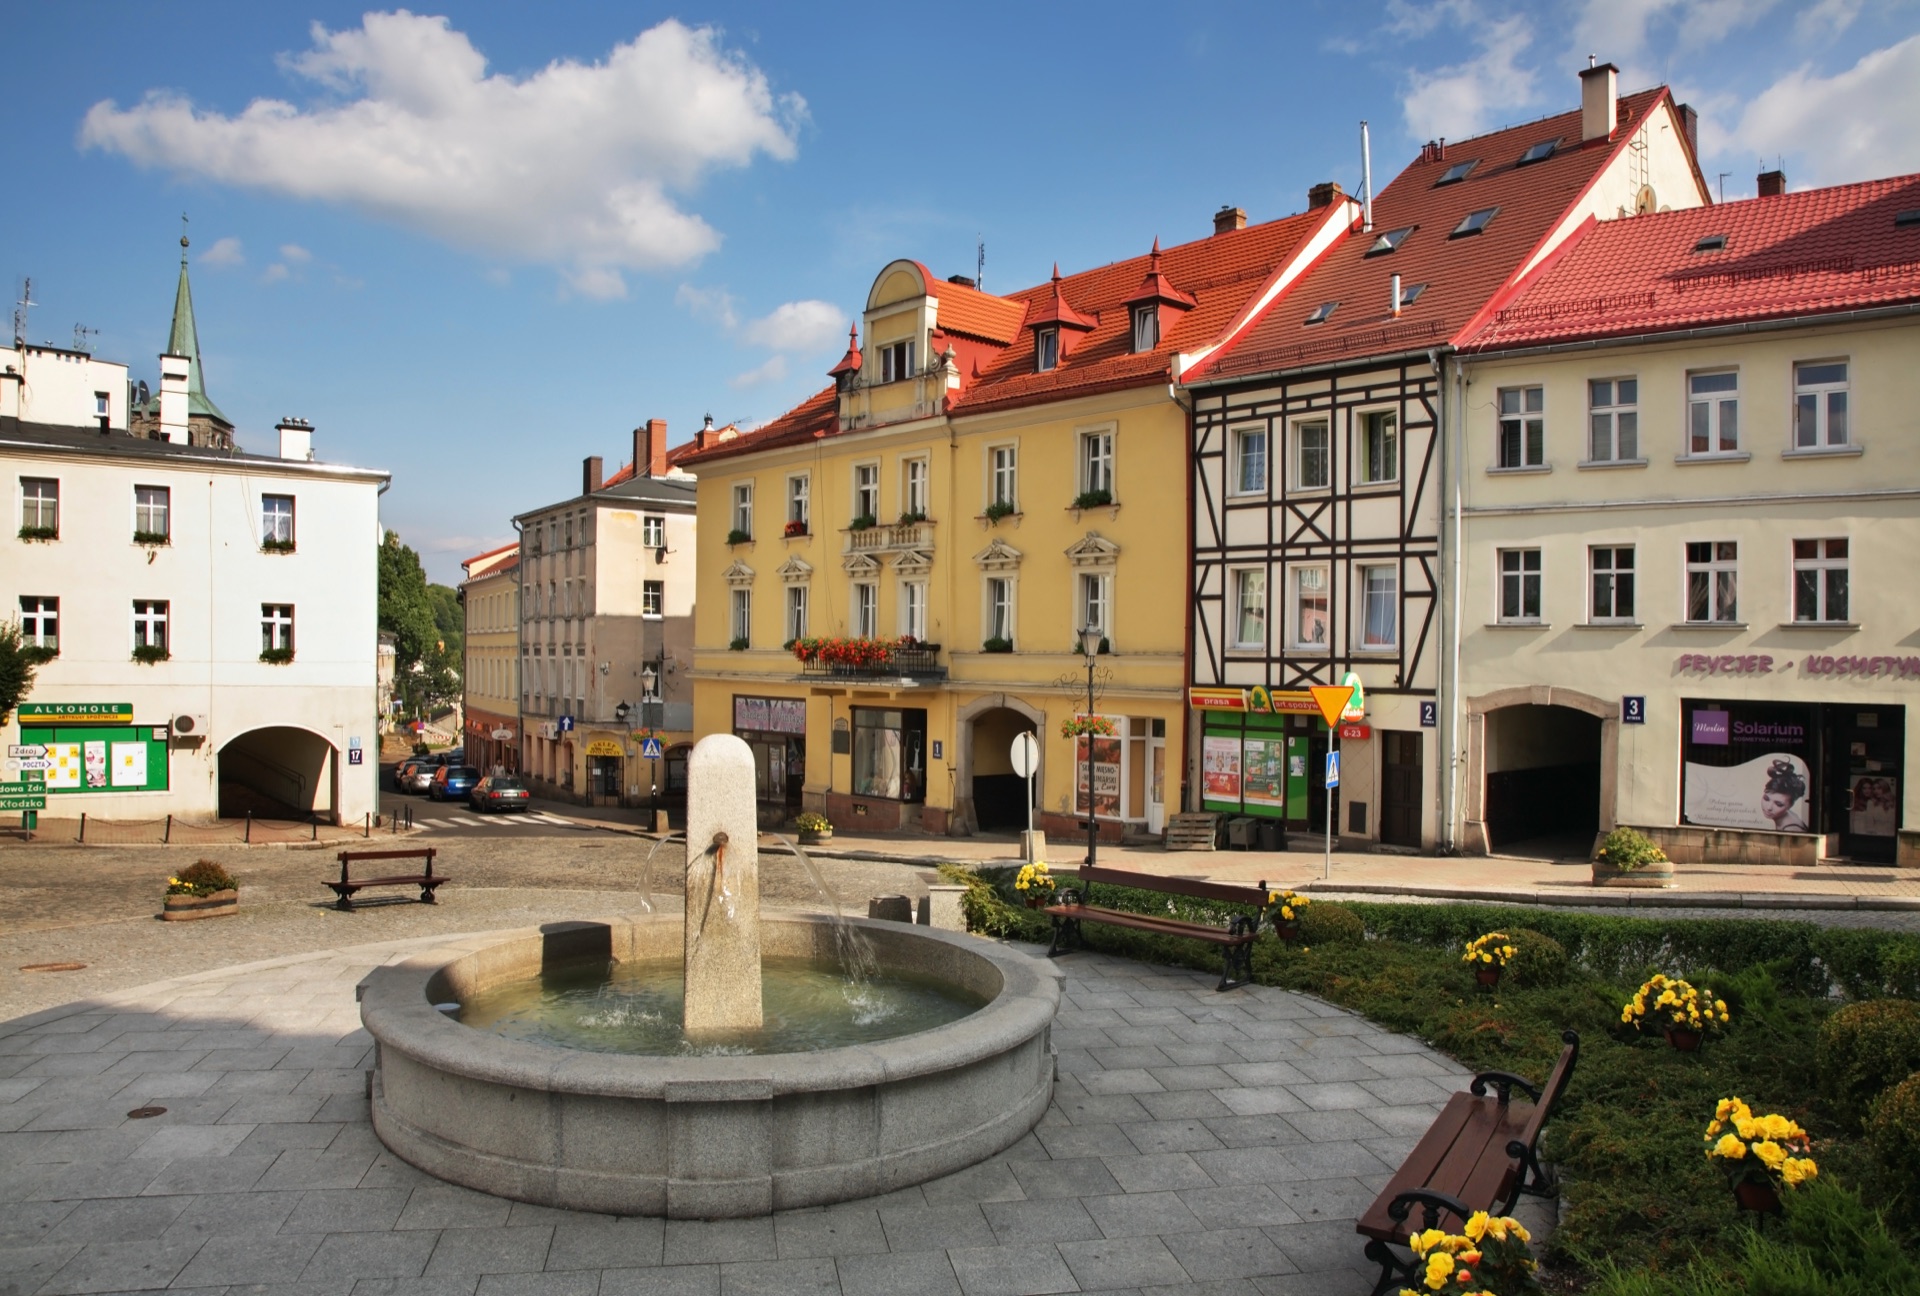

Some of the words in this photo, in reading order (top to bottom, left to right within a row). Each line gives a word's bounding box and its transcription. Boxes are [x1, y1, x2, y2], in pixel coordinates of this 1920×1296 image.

[1679, 653, 1773, 675] FRYZJER
[1204, 697, 1230, 706] prasa
[34, 705, 119, 713] ALKOHOLE
[1425, 704, 1433, 719] 2
[1629, 699, 1638, 715] 3
[1694, 722, 1727, 732] Merlin
[1733, 720, 1803, 736] Solarium
[1343, 729, 1361, 738] 6-23
[351, 750, 361, 760] 17
[27, 784, 45, 792] Zdr.
[0, 799, 43, 808] Kłodzko
